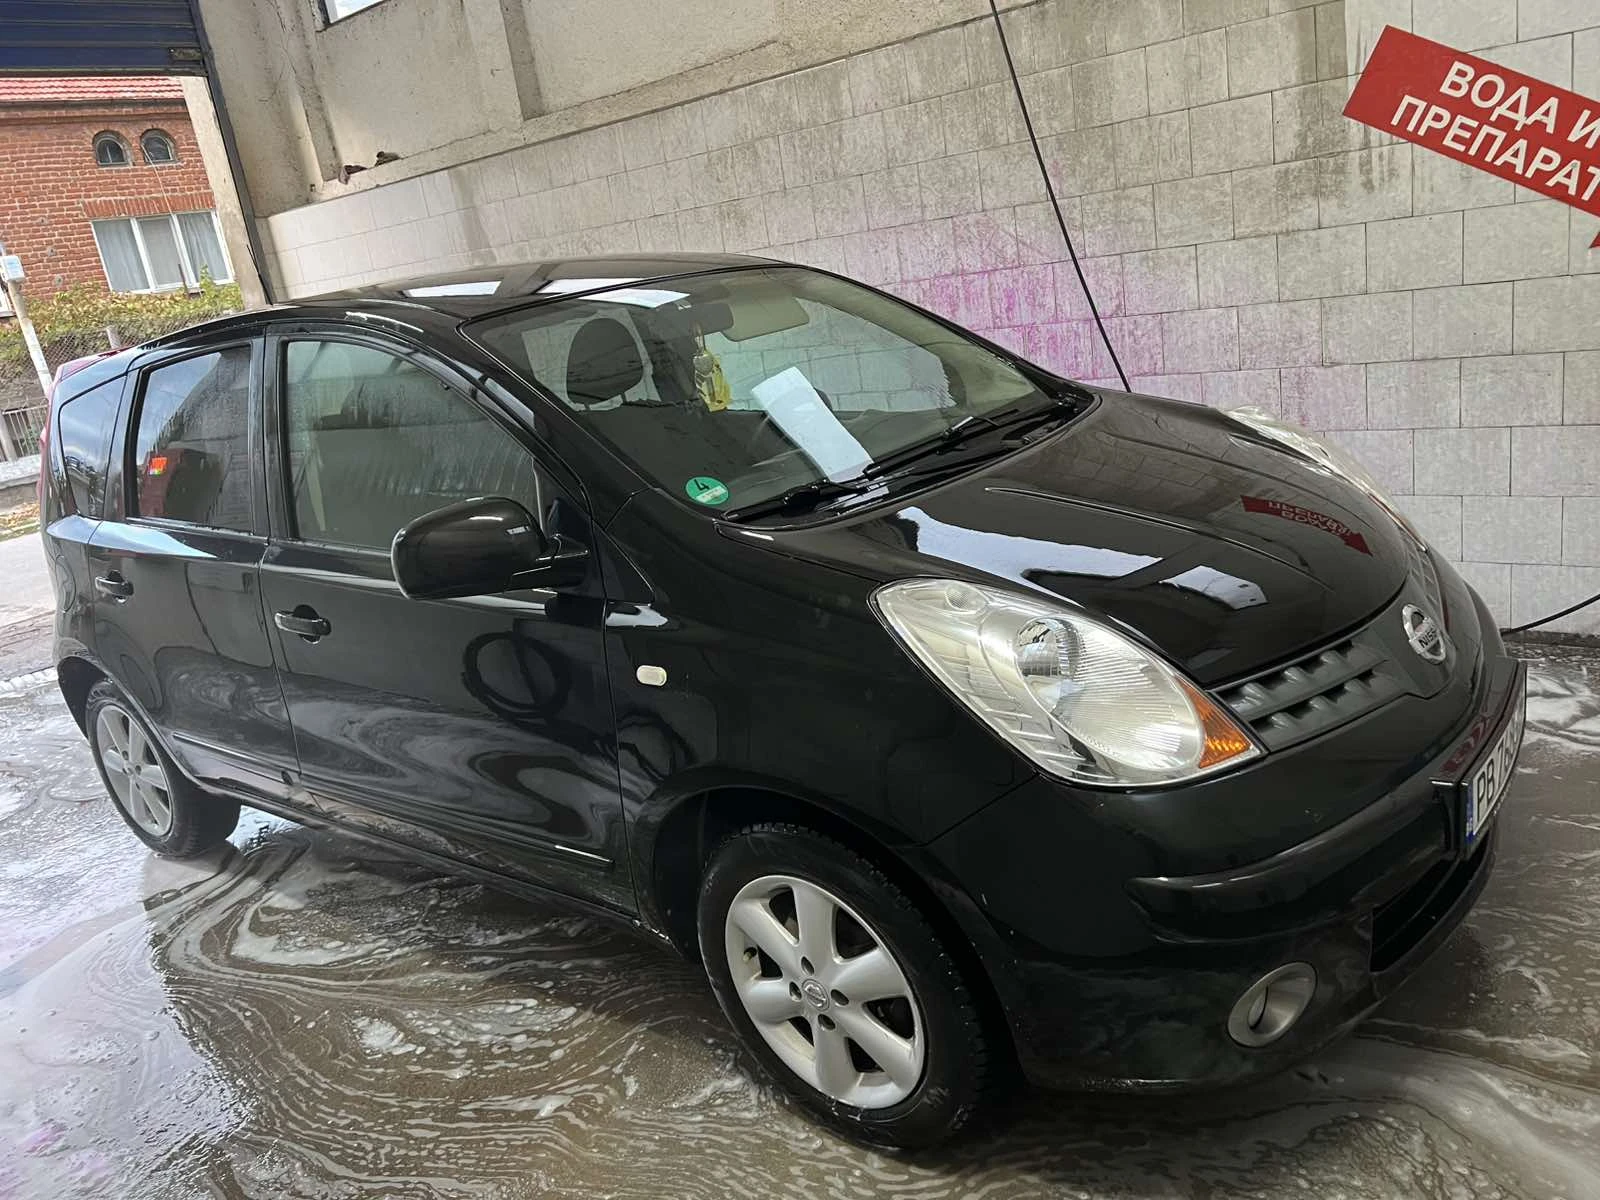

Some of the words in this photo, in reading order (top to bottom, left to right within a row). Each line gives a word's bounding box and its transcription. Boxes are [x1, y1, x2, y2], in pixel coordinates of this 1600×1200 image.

[1439, 60, 1559, 134] ВОДА
[1390, 94, 1600, 201] ПРЕПАРАТ
[694, 479, 710, 491] 4
